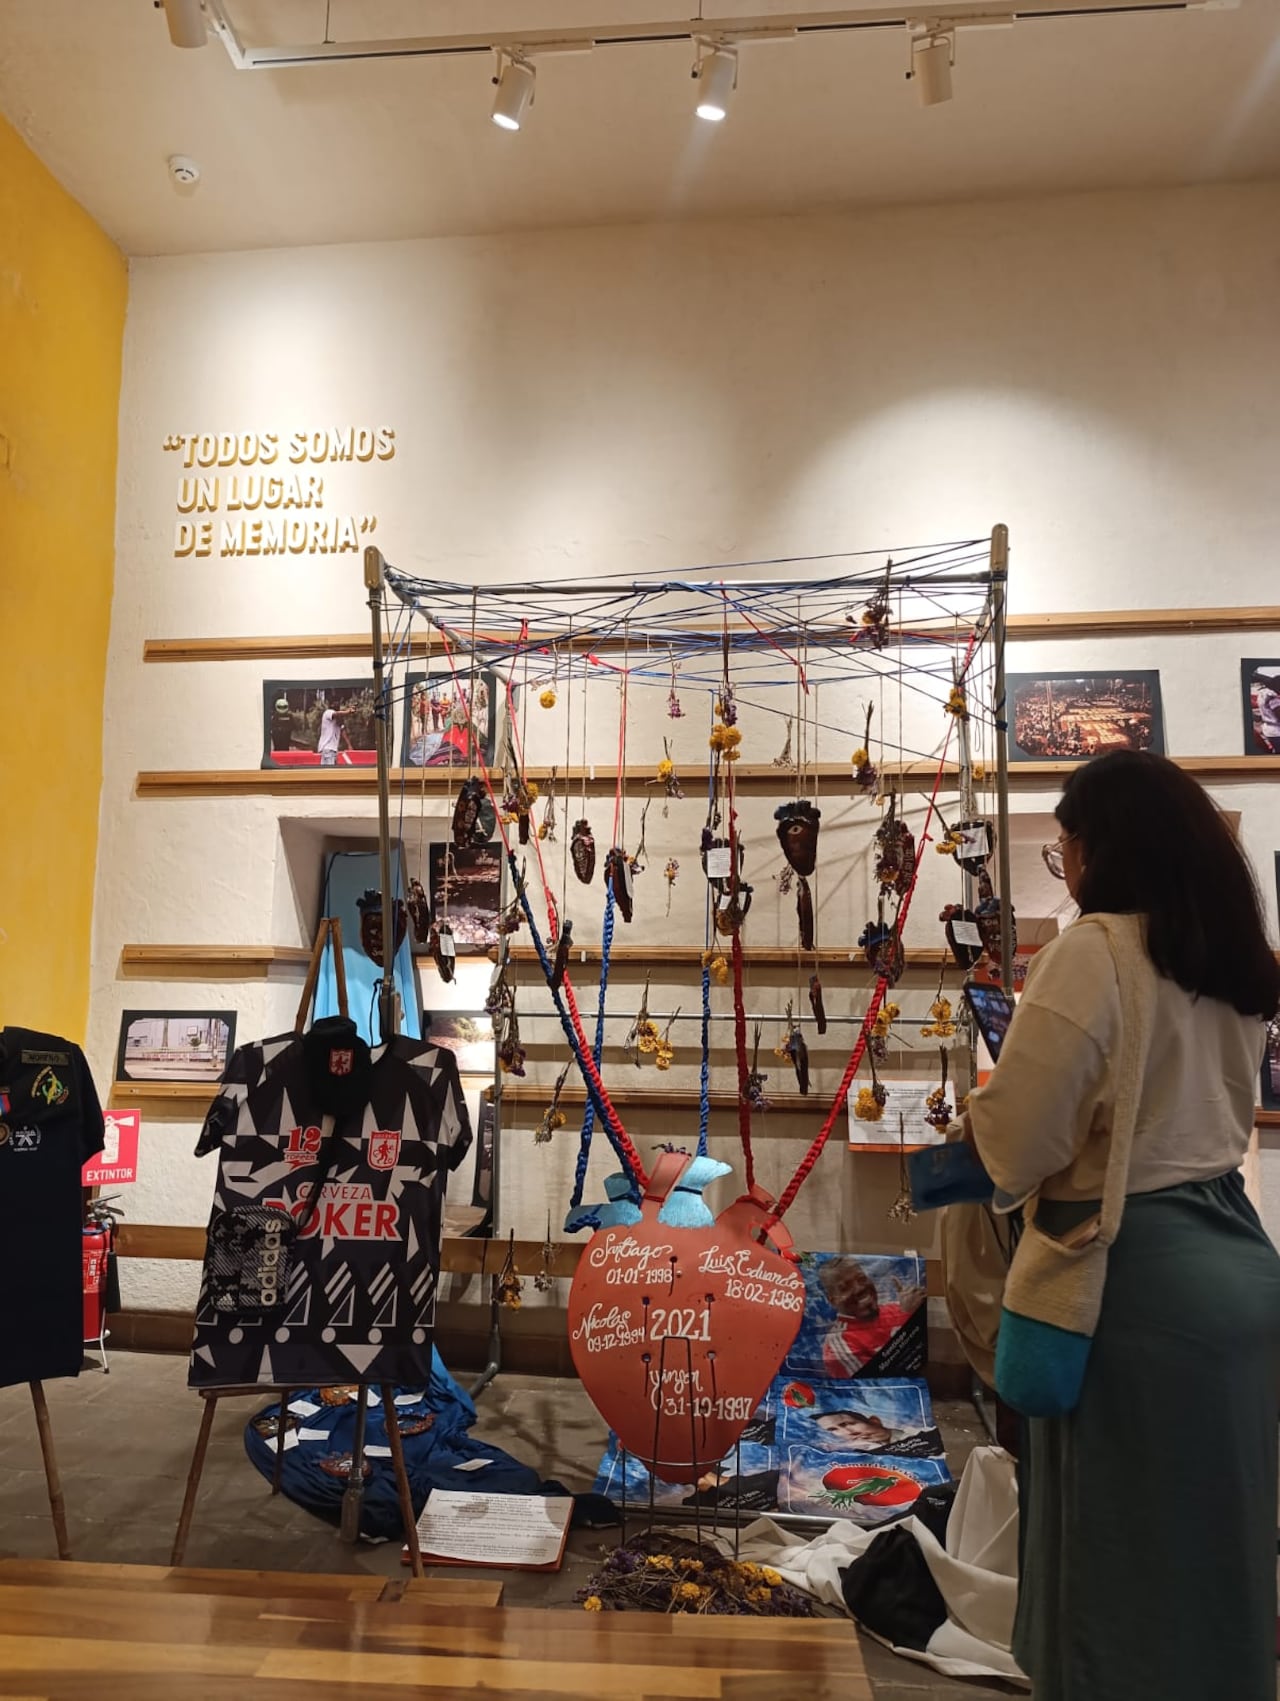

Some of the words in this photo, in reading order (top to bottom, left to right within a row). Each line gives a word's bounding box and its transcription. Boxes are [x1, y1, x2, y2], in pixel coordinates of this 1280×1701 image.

[288, 425, 396, 463] SOMOS
[176, 477, 219, 514] UN
[226, 474, 324, 511] LUGAR
[173, 520, 213, 557] DE
[288, 1126, 322, 1153] 12
[86, 1168, 133, 1182] EXTINTOR
[299, 1184, 372, 1200] CRVEZA
[257, 1219, 281, 1307] adidas
[590, 1233, 673, 1270] Santiago
[698, 1245, 736, 1276] Luis
[650, 1308, 711, 1341] 2021
